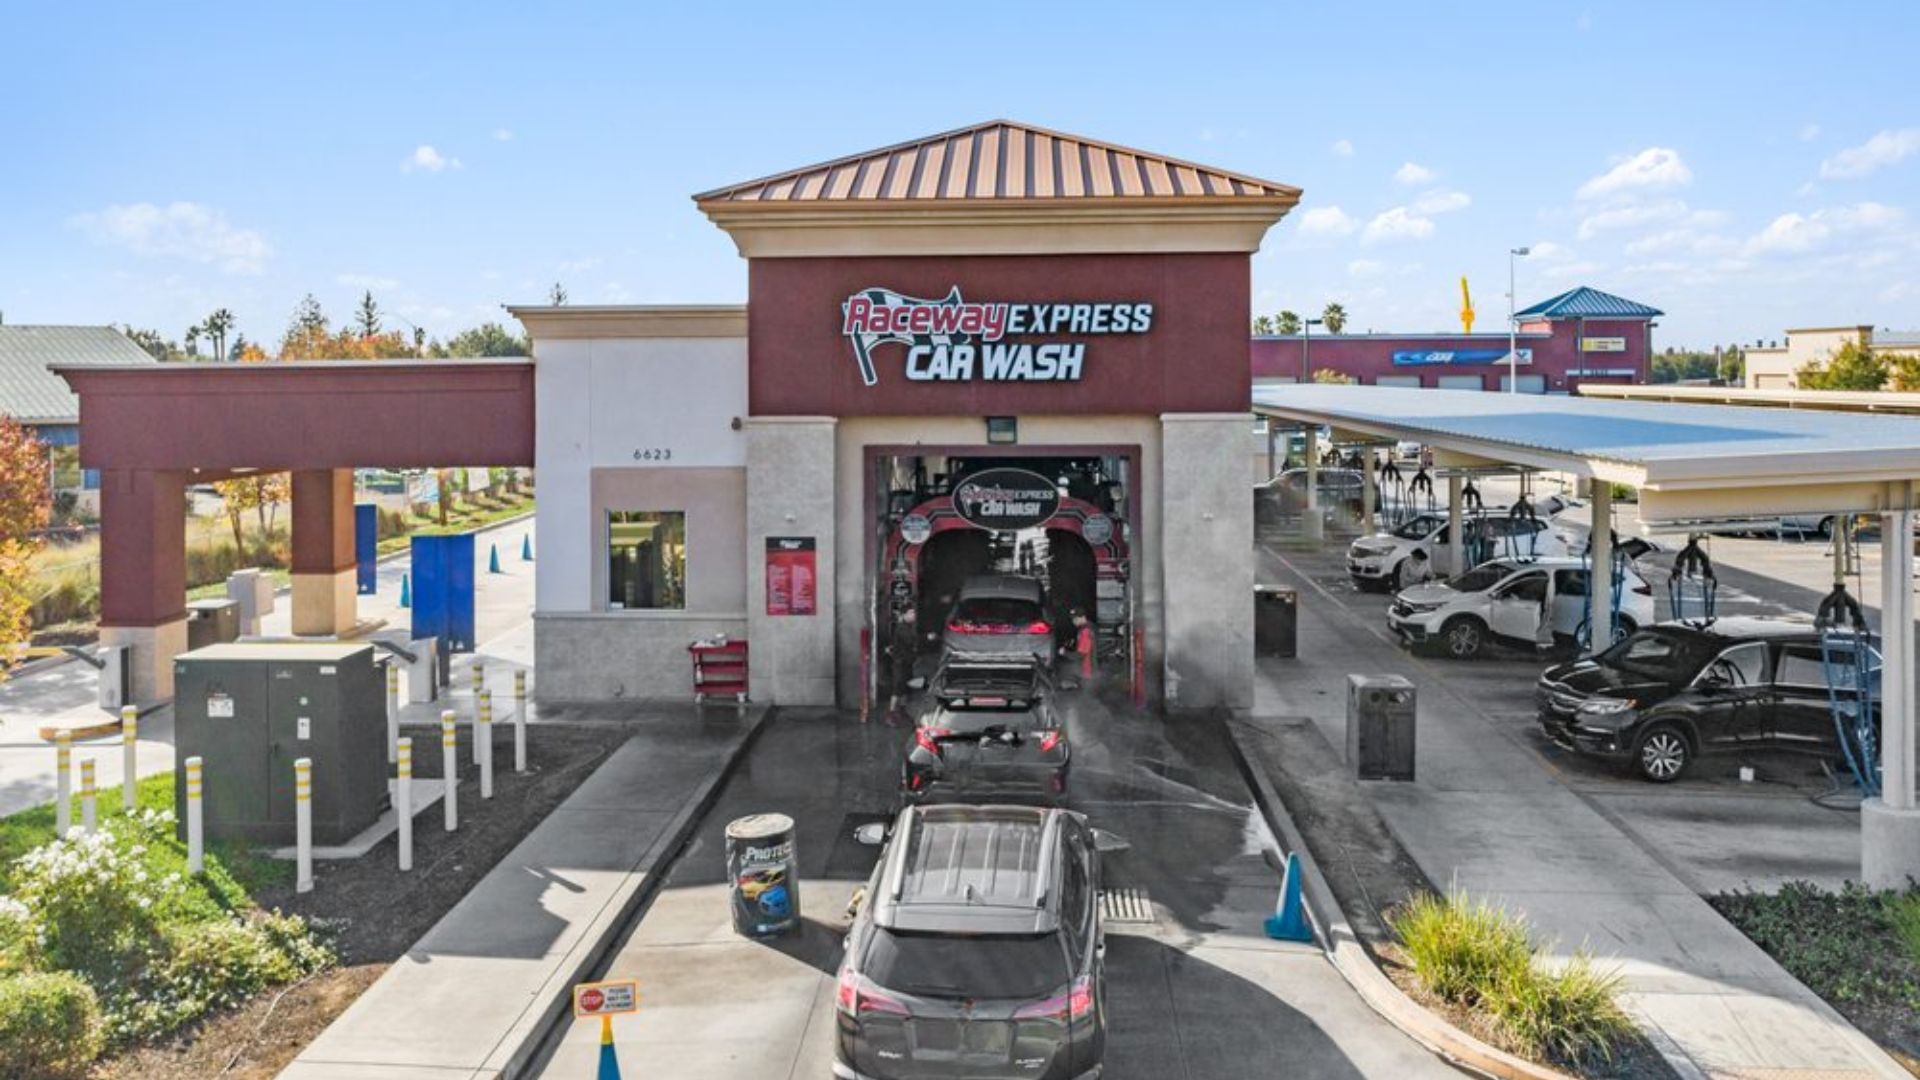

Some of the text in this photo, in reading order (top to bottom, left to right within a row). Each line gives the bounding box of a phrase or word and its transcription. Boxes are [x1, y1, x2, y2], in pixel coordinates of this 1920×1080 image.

[844, 296, 1153, 340] Raceway EXPRESS
[905, 343, 1086, 381] CAR WASH
[633, 449, 671, 461] 6623
[981, 502, 1040, 517] CAR WASH
